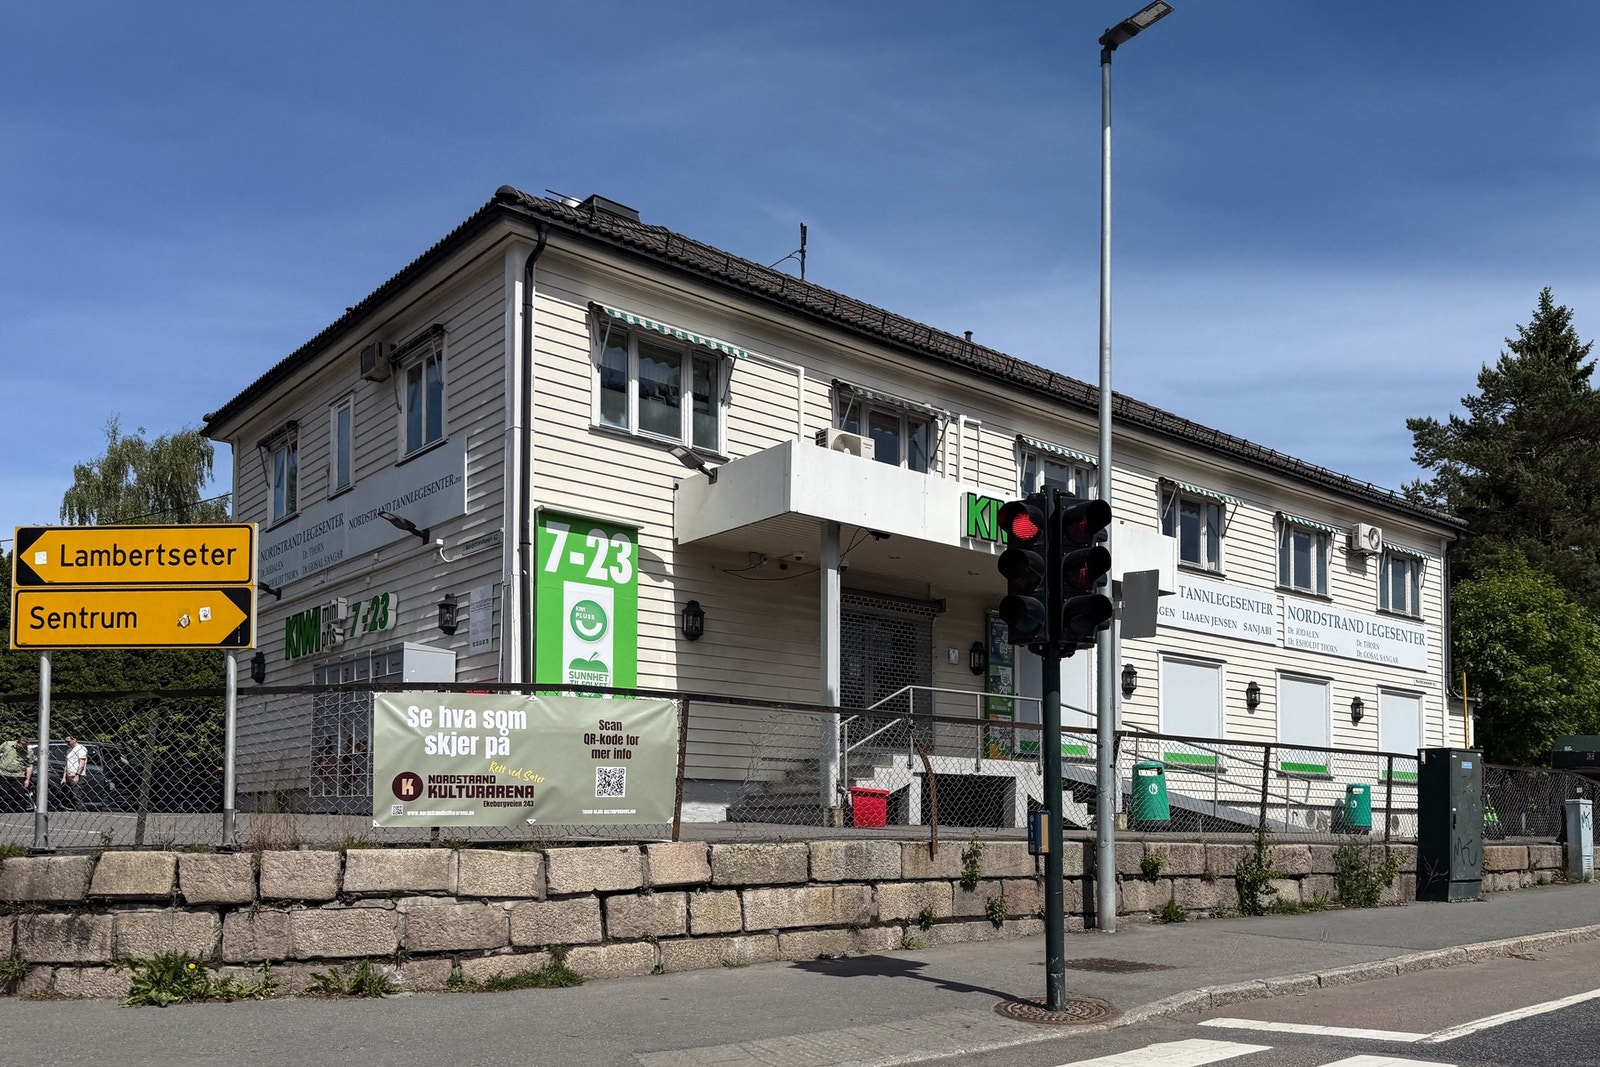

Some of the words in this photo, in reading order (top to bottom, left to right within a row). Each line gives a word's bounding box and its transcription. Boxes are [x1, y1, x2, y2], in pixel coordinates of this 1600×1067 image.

[348, 502, 391, 530] NORDSTRAND
[260, 532, 303, 563] NORDSTRAND
[302, 512, 344, 543] LEGESENTER
[60, 543, 237, 567] Lambertseter
[323, 549, 344, 566] SANGAR
[544, 520, 633, 585] 7-23
[1178, 585, 1274, 616] TANNLEGESENTER
[29, 606, 137, 629] Sentrum
[322, 601, 339, 625] mini
[349, 591, 390, 638] 7-23
[575, 612, 596, 620] PLUSS
[1157, 605, 1176, 618] GEN
[1182, 610, 1210, 625] LIAAEN
[1210, 616, 1238, 630] JENSEN
[1243, 622, 1272, 636] SANJABI
[285, 605, 321, 660] KIWI
[1287, 605, 1364, 634] NORDSTRAND
[1366, 621, 1426, 646] LEGESENTER
[321, 625, 337, 652] pris
[1320, 643, 1338, 653] THORN
[1363, 640, 1380, 651] THORN
[1379, 653, 1399, 665] SANGAR
[568, 670, 609, 683] SUNNHET
[407, 705, 433, 728] Se
[438, 705, 477, 729] hva
[482, 709, 527, 730] som
[598, 719, 622, 731] Scan
[424, 732, 480, 757] skjer
[485, 728, 510, 759] på
[583, 733, 624, 745] QR-kode
[626, 734, 640, 745] for
[591, 748, 611, 759] mer
[613, 748, 632, 760] info
[428, 774, 497, 784] NORDSTRAND
[488, 760, 506, 774] Rett
[508, 767, 523, 779] ved
[401, 778, 414, 795] K
[427, 785, 534, 798] KULTURARENA
[483, 800, 522, 809] Ekebergveien
[523, 800, 534, 808] 243
